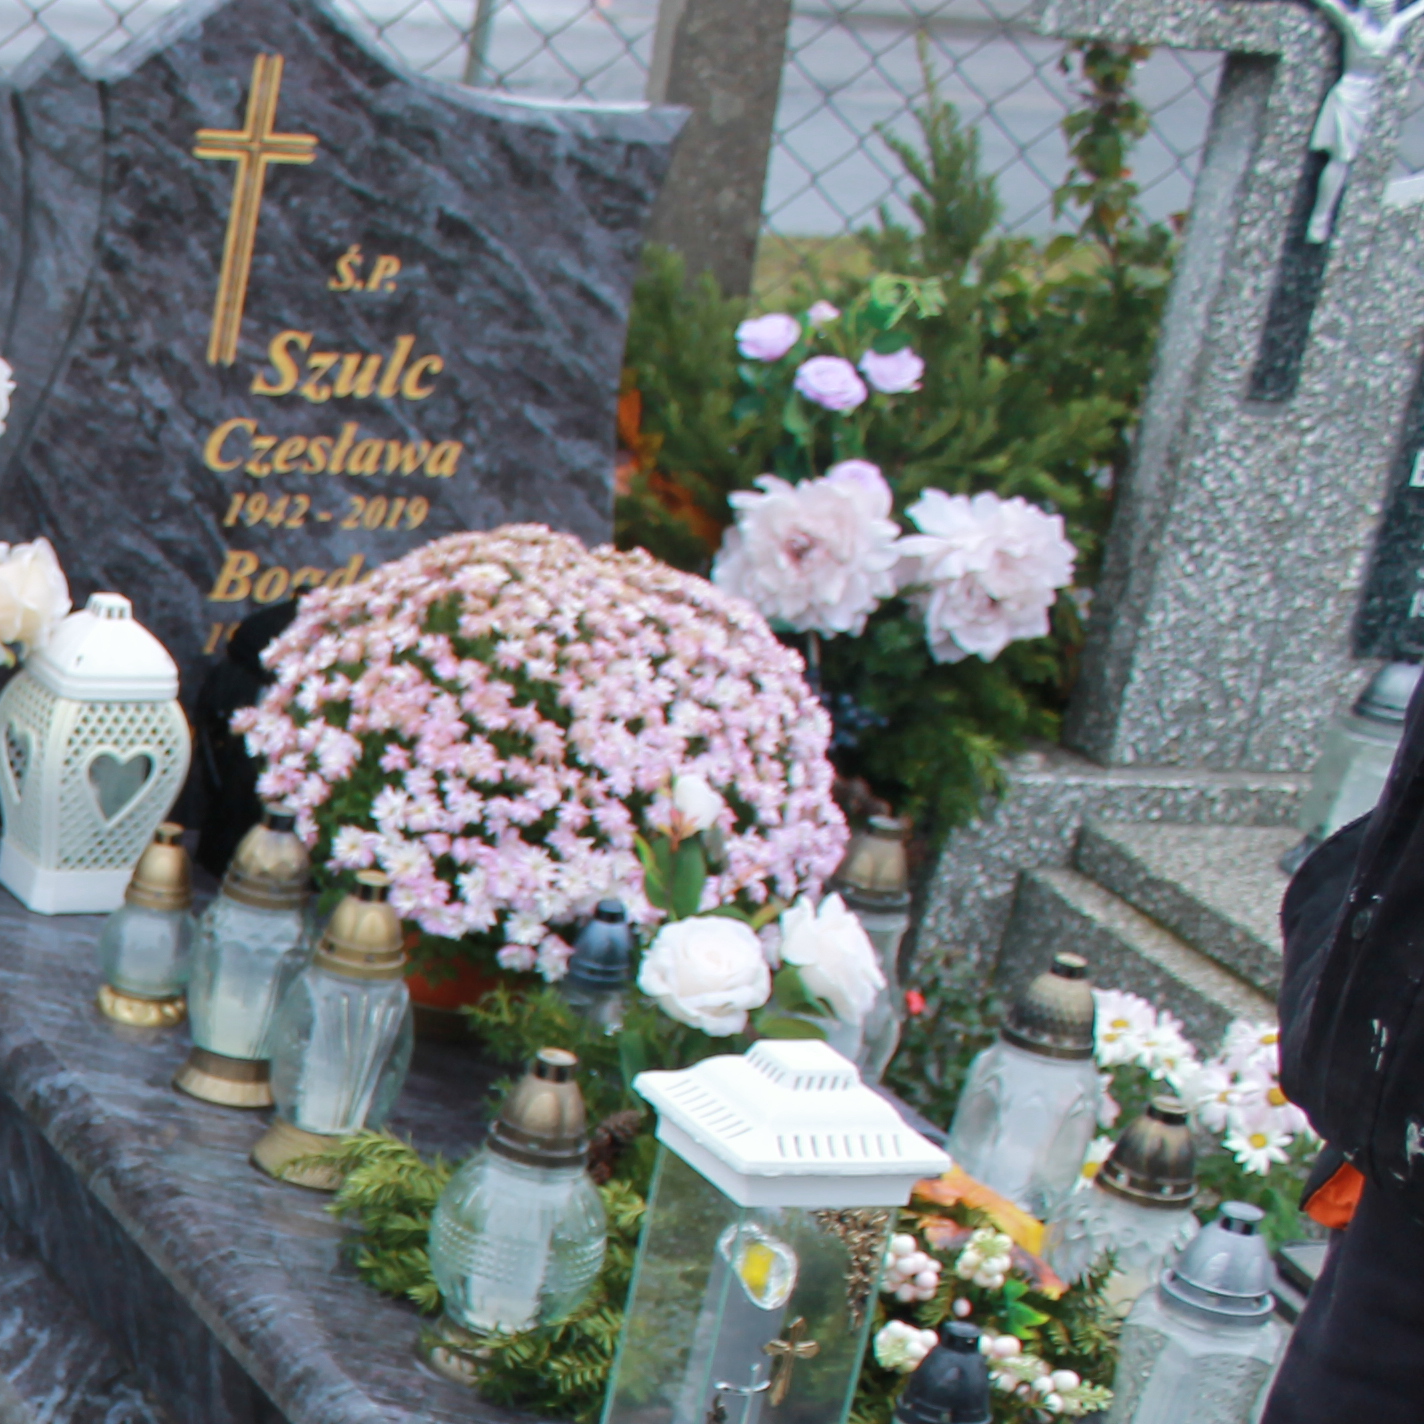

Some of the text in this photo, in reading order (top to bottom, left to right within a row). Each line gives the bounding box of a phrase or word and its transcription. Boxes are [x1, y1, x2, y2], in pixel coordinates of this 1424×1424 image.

[251, 331, 444, 402] Szulc
[222, 491, 311, 528] 1942
[340, 495, 430, 530] 2019
